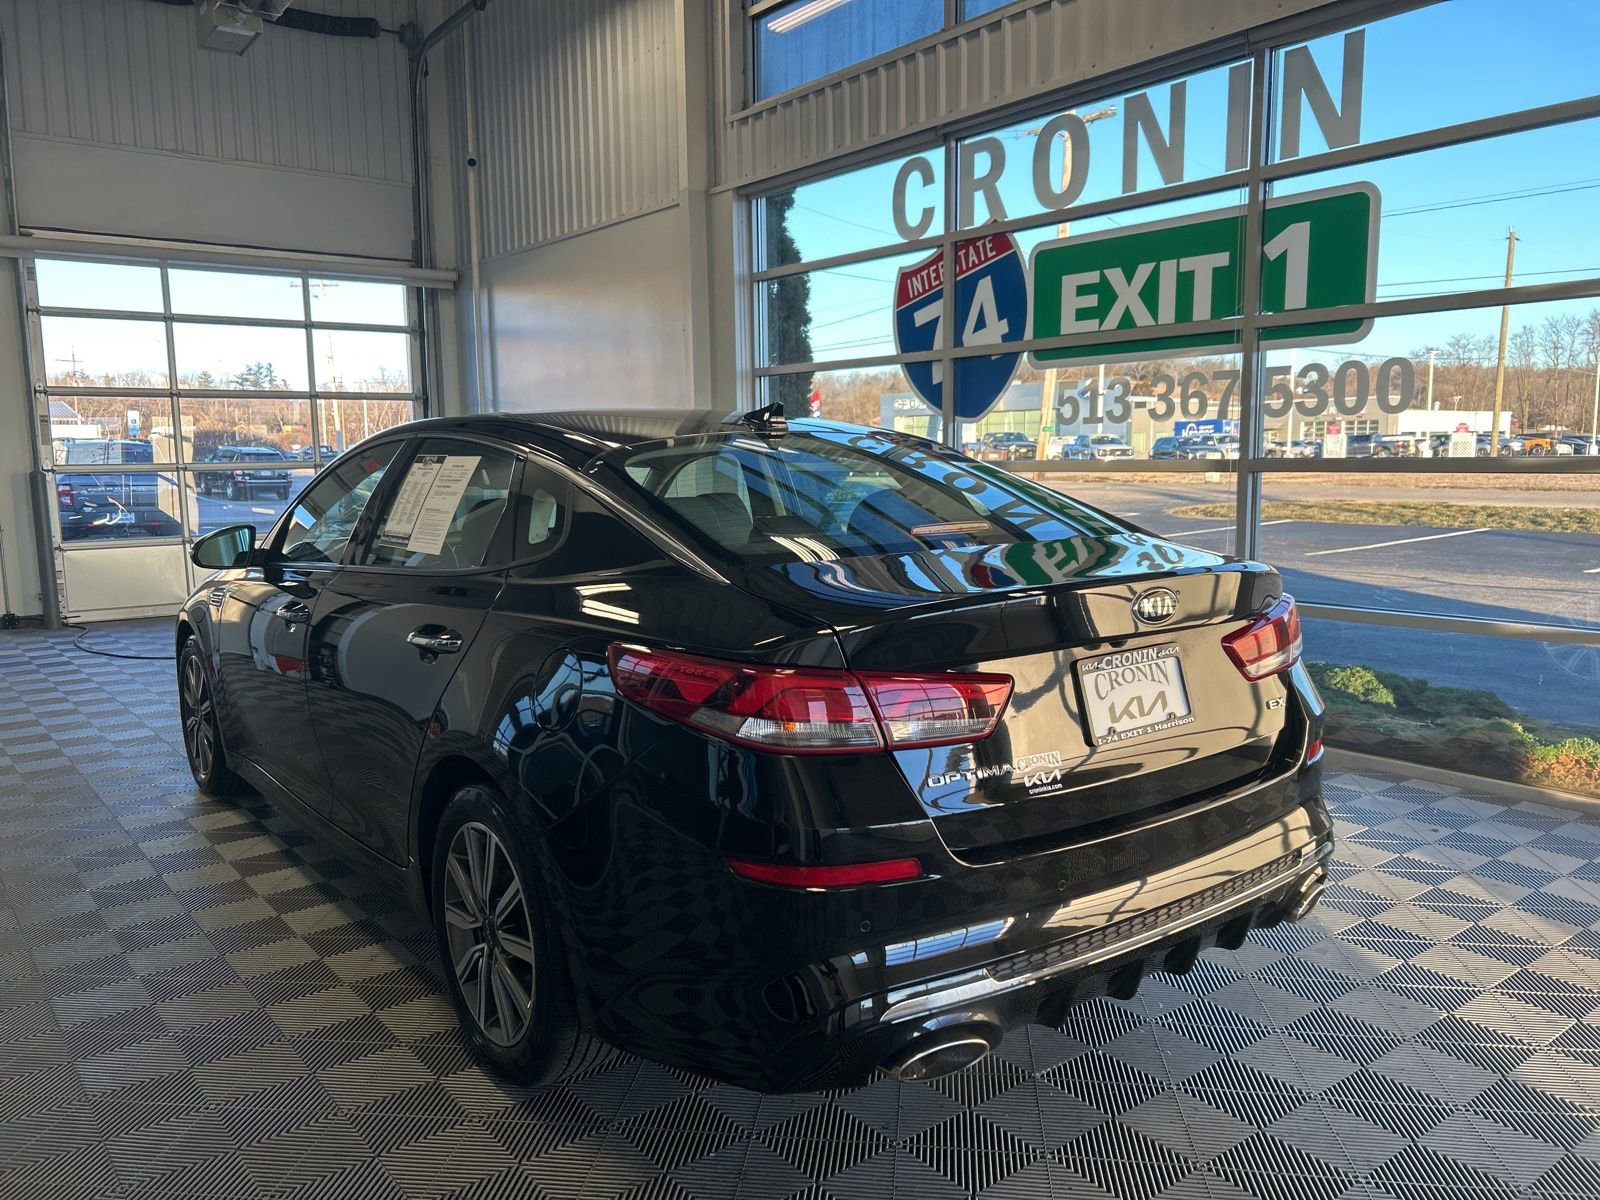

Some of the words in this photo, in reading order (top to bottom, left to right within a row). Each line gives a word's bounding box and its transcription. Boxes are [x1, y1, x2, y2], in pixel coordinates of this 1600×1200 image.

[892, 28, 1366, 241] CRONIN
[1060, 251, 1230, 336] EXIT
[1263, 221, 1311, 311] 1
[913, 275, 1009, 385] 74
[1140, 596, 1174, 618] KIA
[1102, 647, 1158, 670] CRONIN
[1094, 661, 1171, 701] CRONIN
[1108, 690, 1168, 725] KIA
[1269, 697, 1286, 710] EX
[1097, 734, 1119, 746] I-74
[1120, 728, 1144, 740] EXIT
[1146, 726, 1153, 734] 1
[1154, 716, 1195, 731] Harrison
[1016, 752, 1061, 770] CRONIN
[927, 763, 1015, 788] OPTIMA
[1023, 768, 1062, 787] KIA
[1029, 783, 1064, 795] croninkia.com
